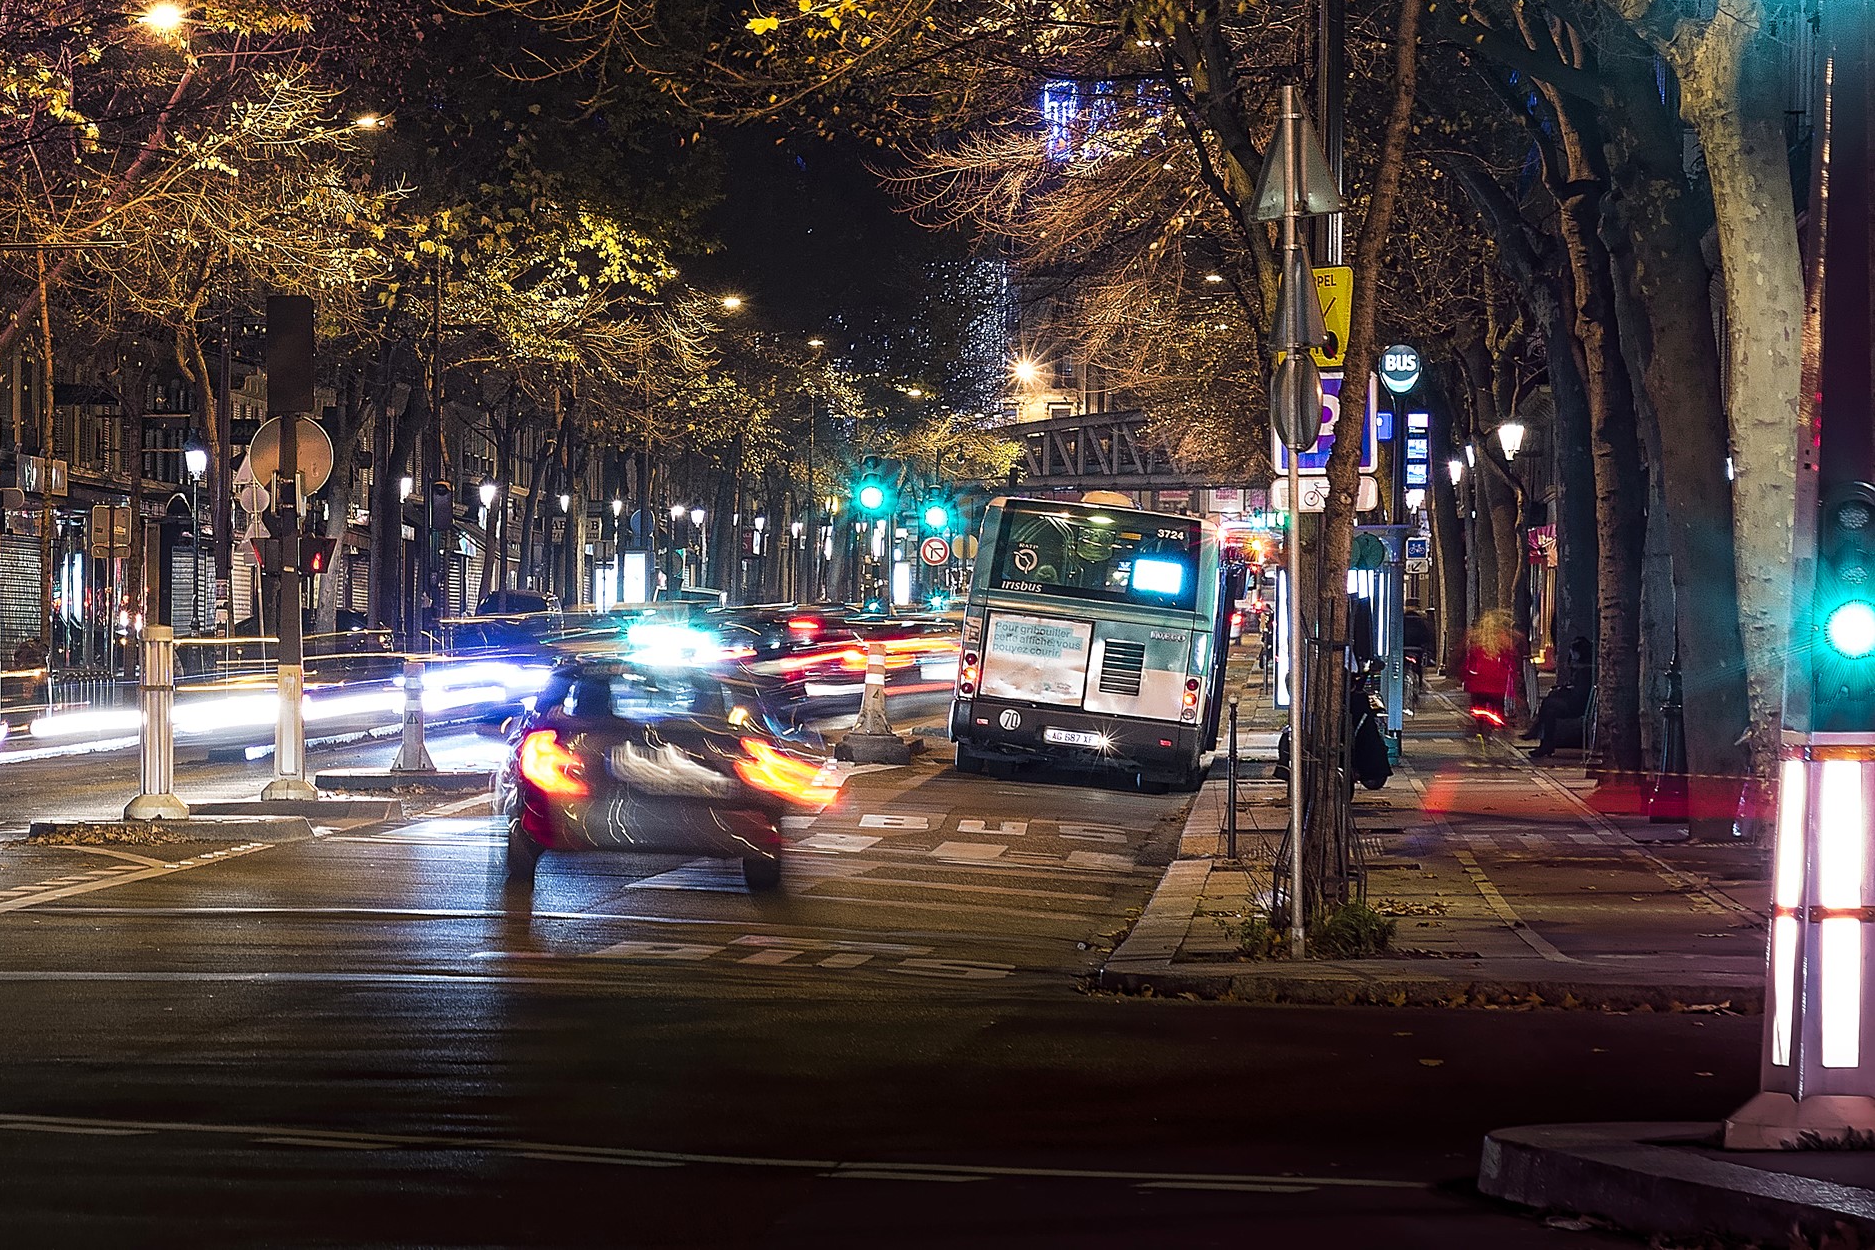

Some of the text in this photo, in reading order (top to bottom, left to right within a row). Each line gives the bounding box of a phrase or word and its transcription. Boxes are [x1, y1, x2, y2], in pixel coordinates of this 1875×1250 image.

[1385, 354, 1418, 372] BUS
[1157, 528, 1185, 541] 3724
[1018, 542, 1039, 550] RATP
[1001, 580, 1043, 593] irisbus
[995, 621, 1071, 638] Pour gribouiller
[992, 643, 1029, 654] pouvez
[1057, 640, 1082, 650] vous
[1004, 711, 1018, 727] 70
[858, 813, 1128, 844] BUS
